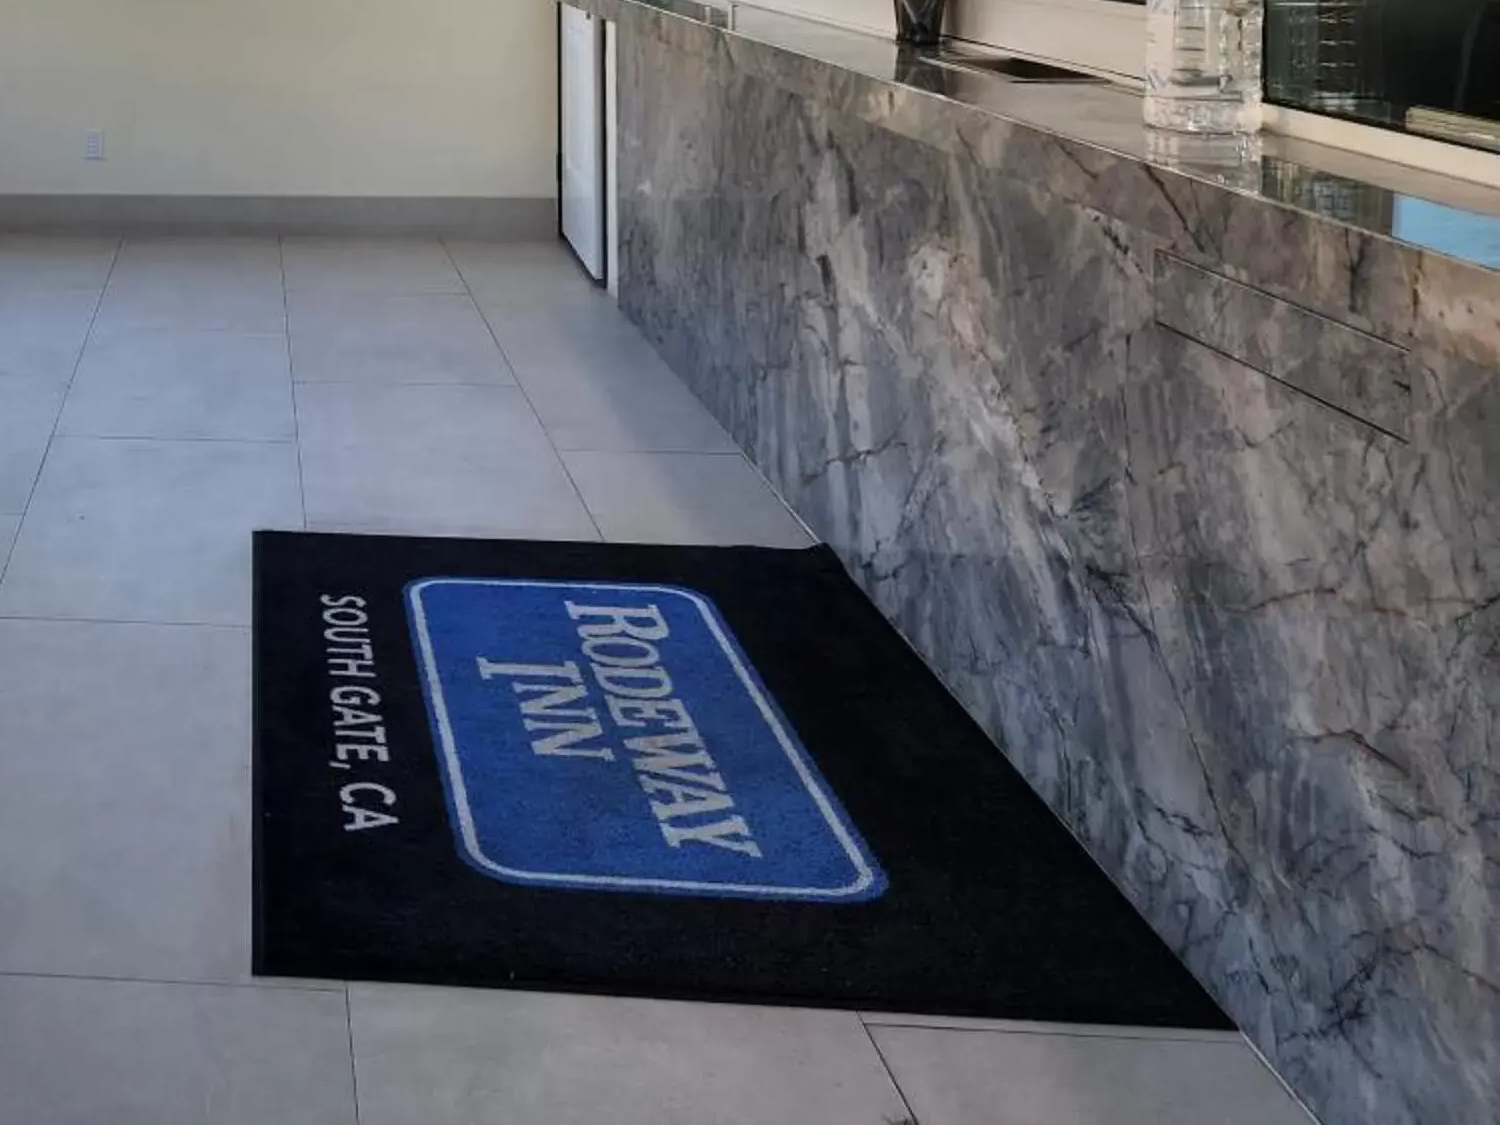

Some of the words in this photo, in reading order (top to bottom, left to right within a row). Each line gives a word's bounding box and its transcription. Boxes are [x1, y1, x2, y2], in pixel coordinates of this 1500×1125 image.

[320, 594, 377, 678] SOUTH
[329, 685, 391, 770] GATE,
[475, 656, 616, 762] INN
[563, 600, 763, 858] RODEWAY
[339, 781, 399, 832] CA
